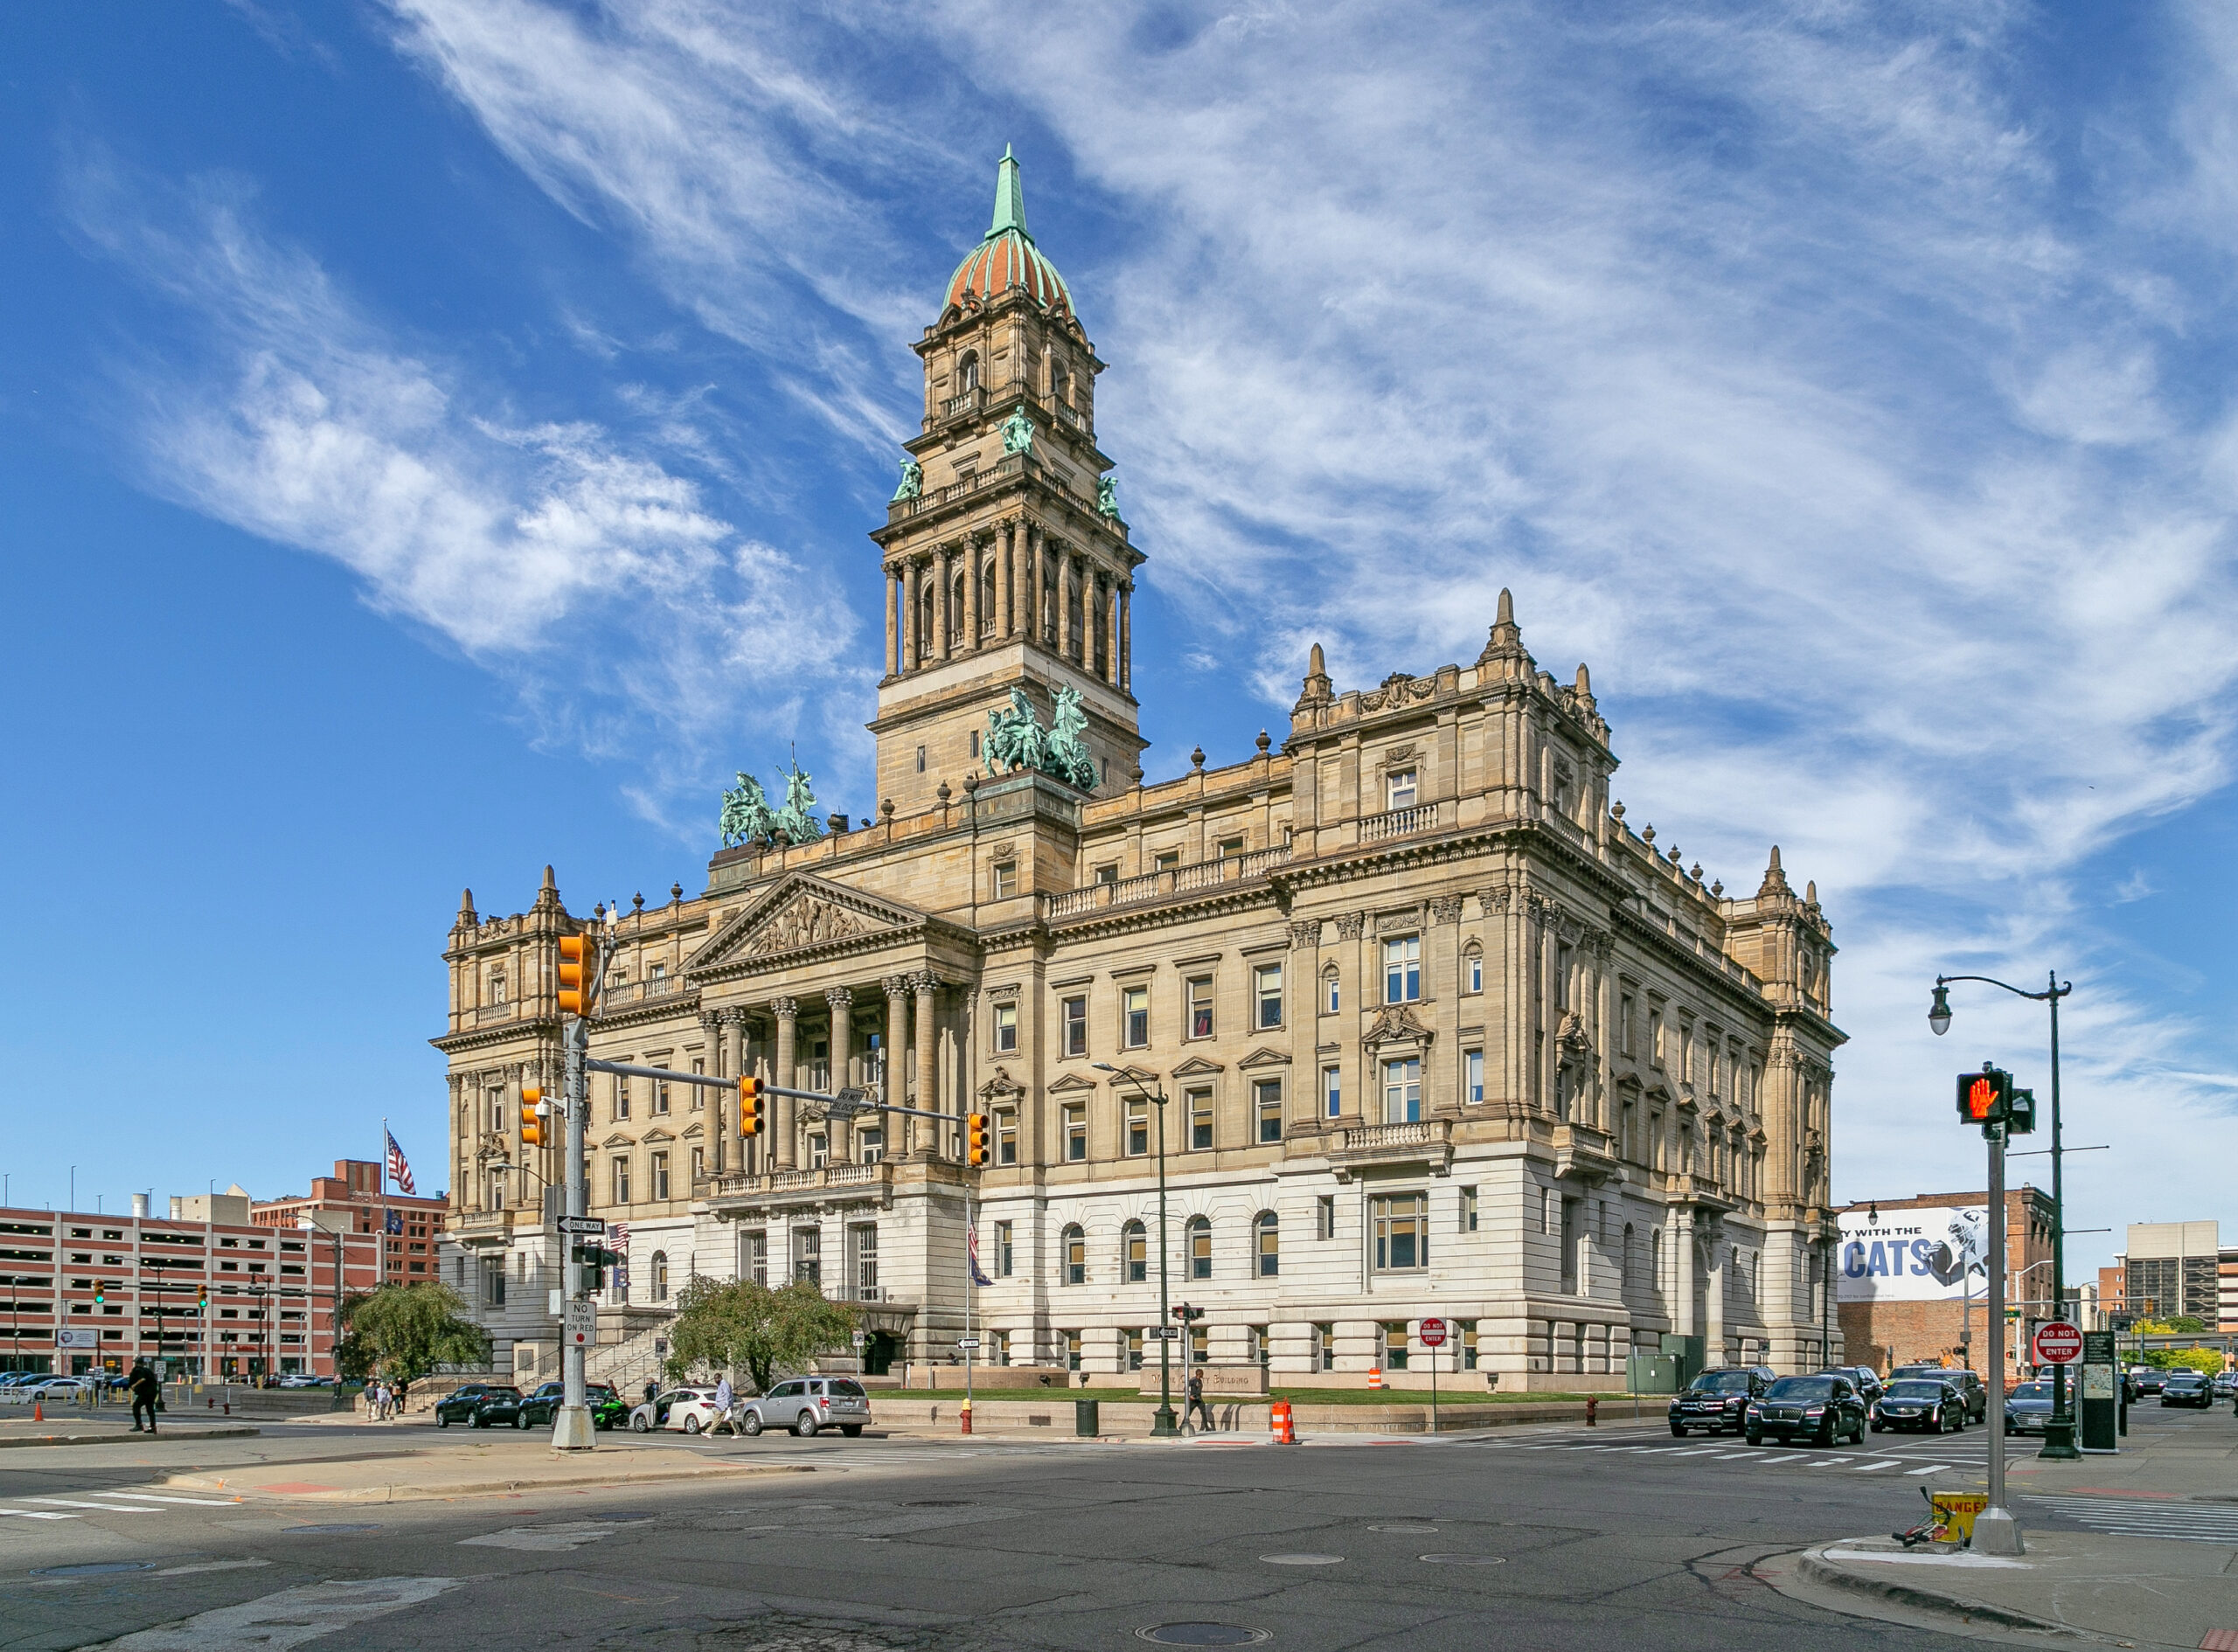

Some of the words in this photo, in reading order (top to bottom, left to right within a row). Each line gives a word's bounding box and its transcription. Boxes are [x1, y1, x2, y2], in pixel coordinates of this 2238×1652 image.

[1855, 1228, 1890, 1237] WITH
[1844, 1239, 1931, 1278] CATS
[573, 1304, 587, 1313] NO
